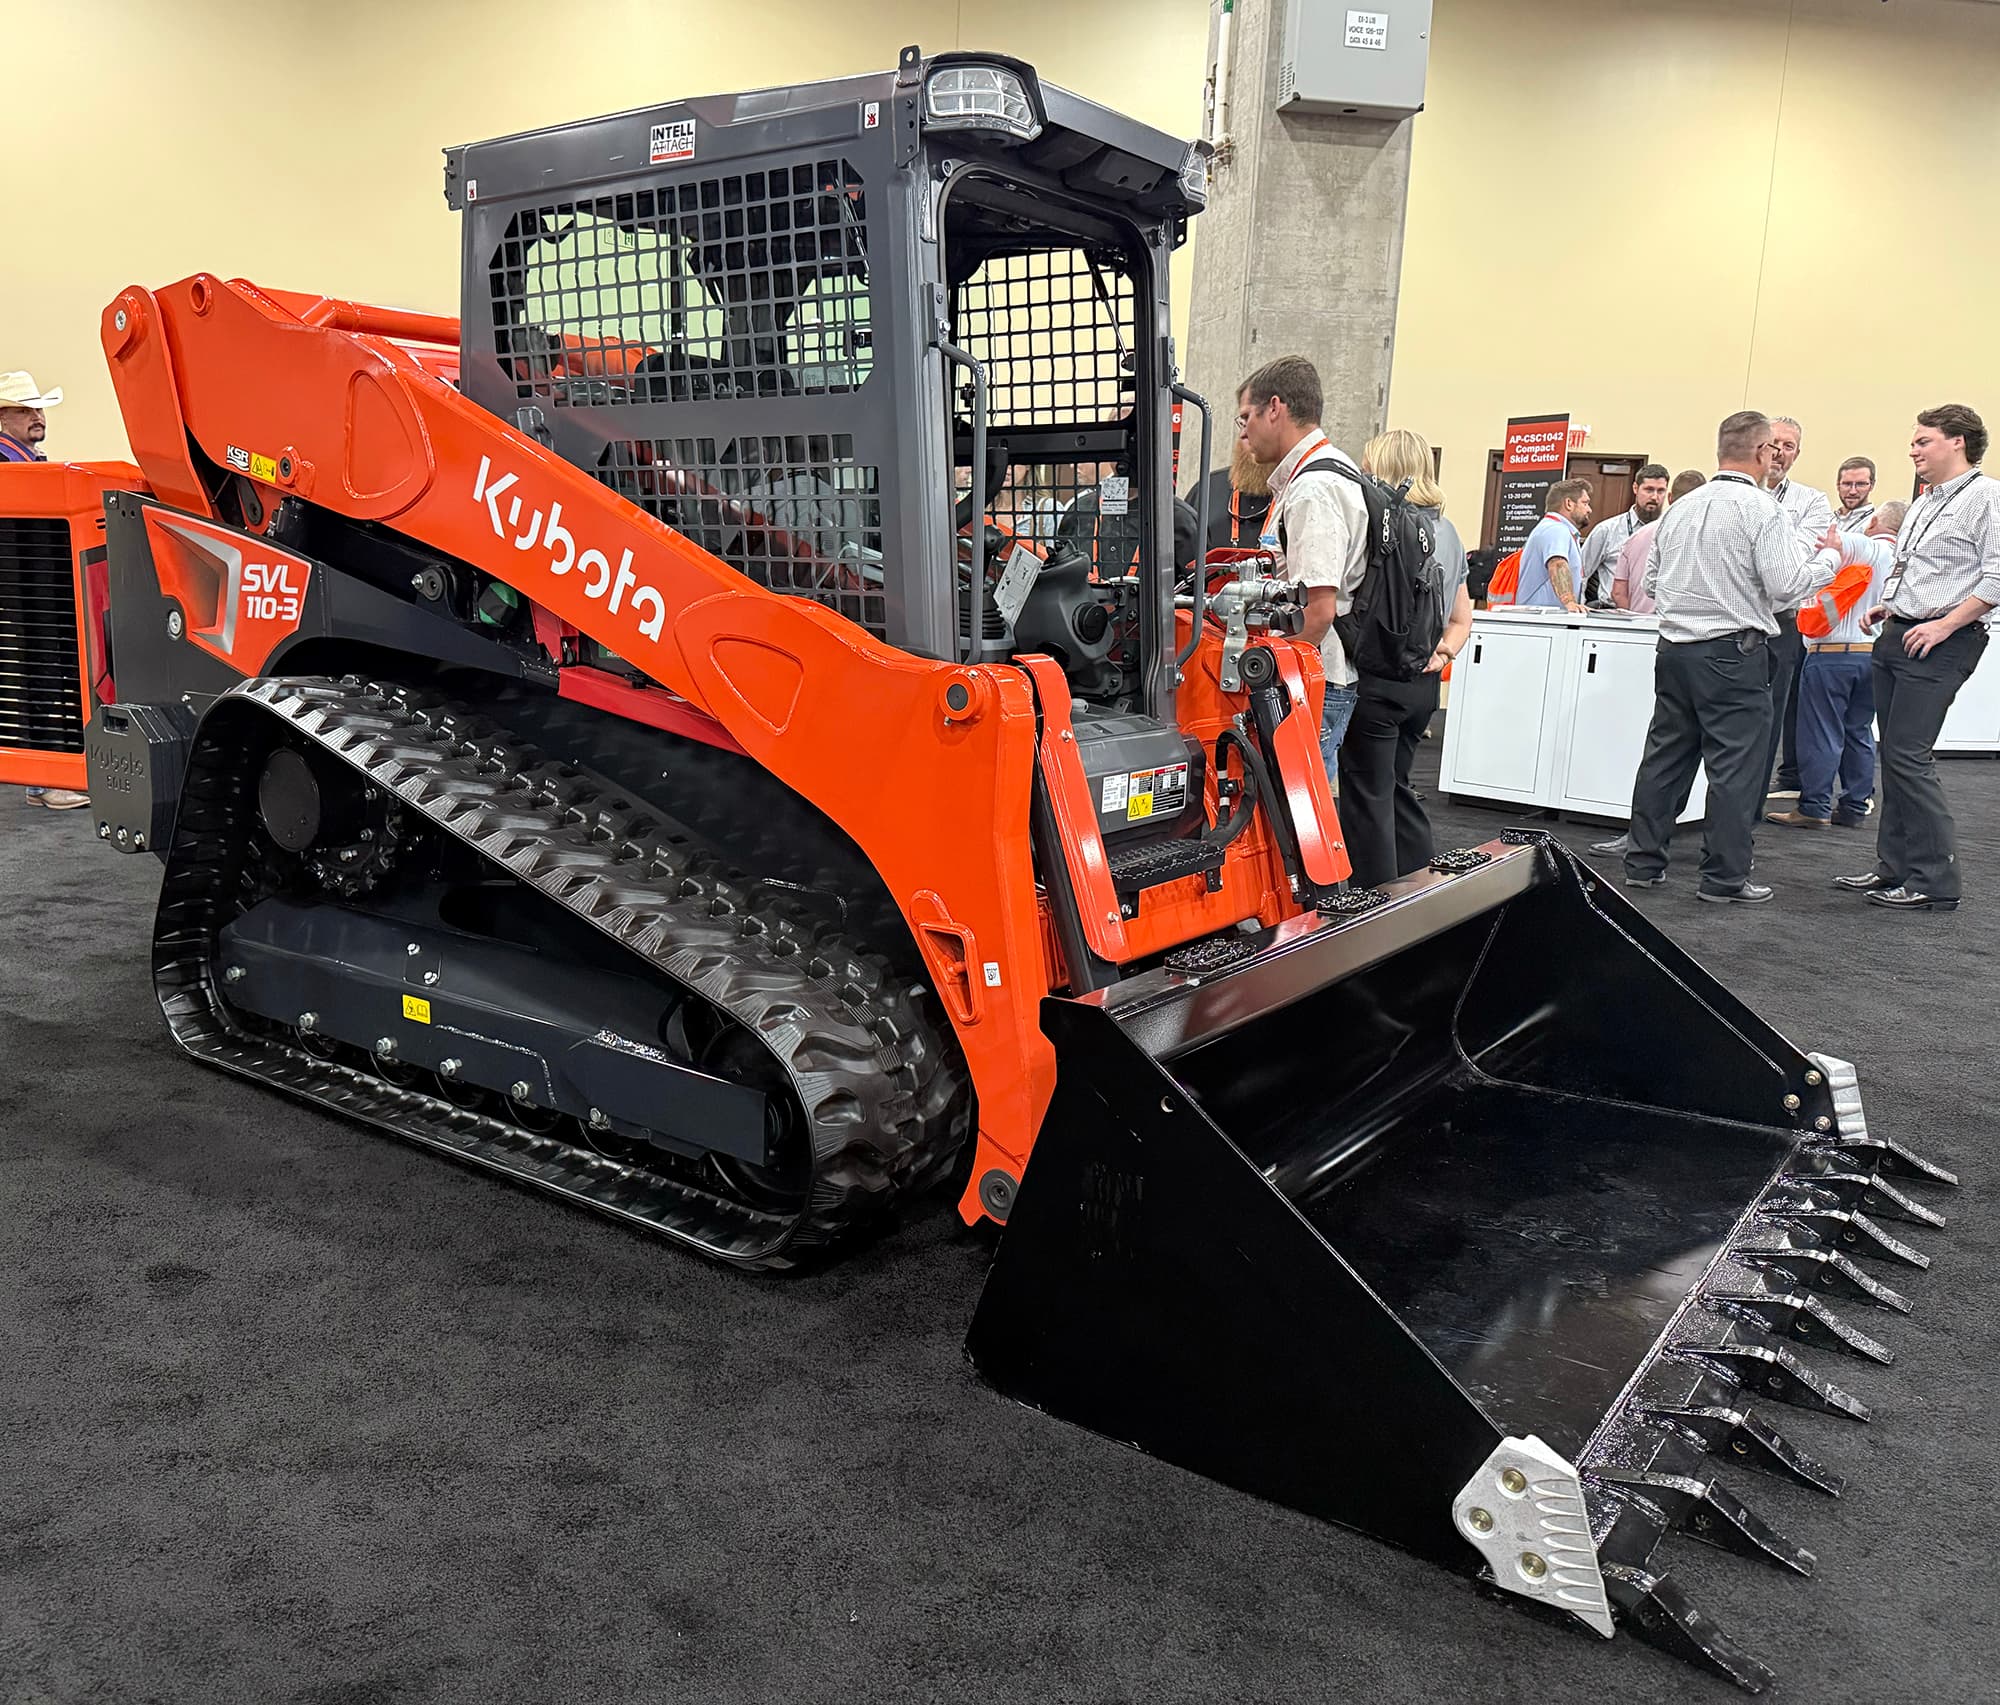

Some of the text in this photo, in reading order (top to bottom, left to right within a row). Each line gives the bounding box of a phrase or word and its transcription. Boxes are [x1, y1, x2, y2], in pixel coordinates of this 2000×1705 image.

[652, 123, 693, 141] INTELL
[652, 136, 694, 154] ATTACH
[1509, 432, 1564, 444] AP-CSC1042
[227, 445, 249, 463] KSR
[1510, 453, 1560, 464] Skid Cutter
[1515, 443, 1556, 456] Compact
[472, 454, 666, 644] Kubota
[241, 564, 299, 594] SVL
[247, 596, 299, 620] 110-3
